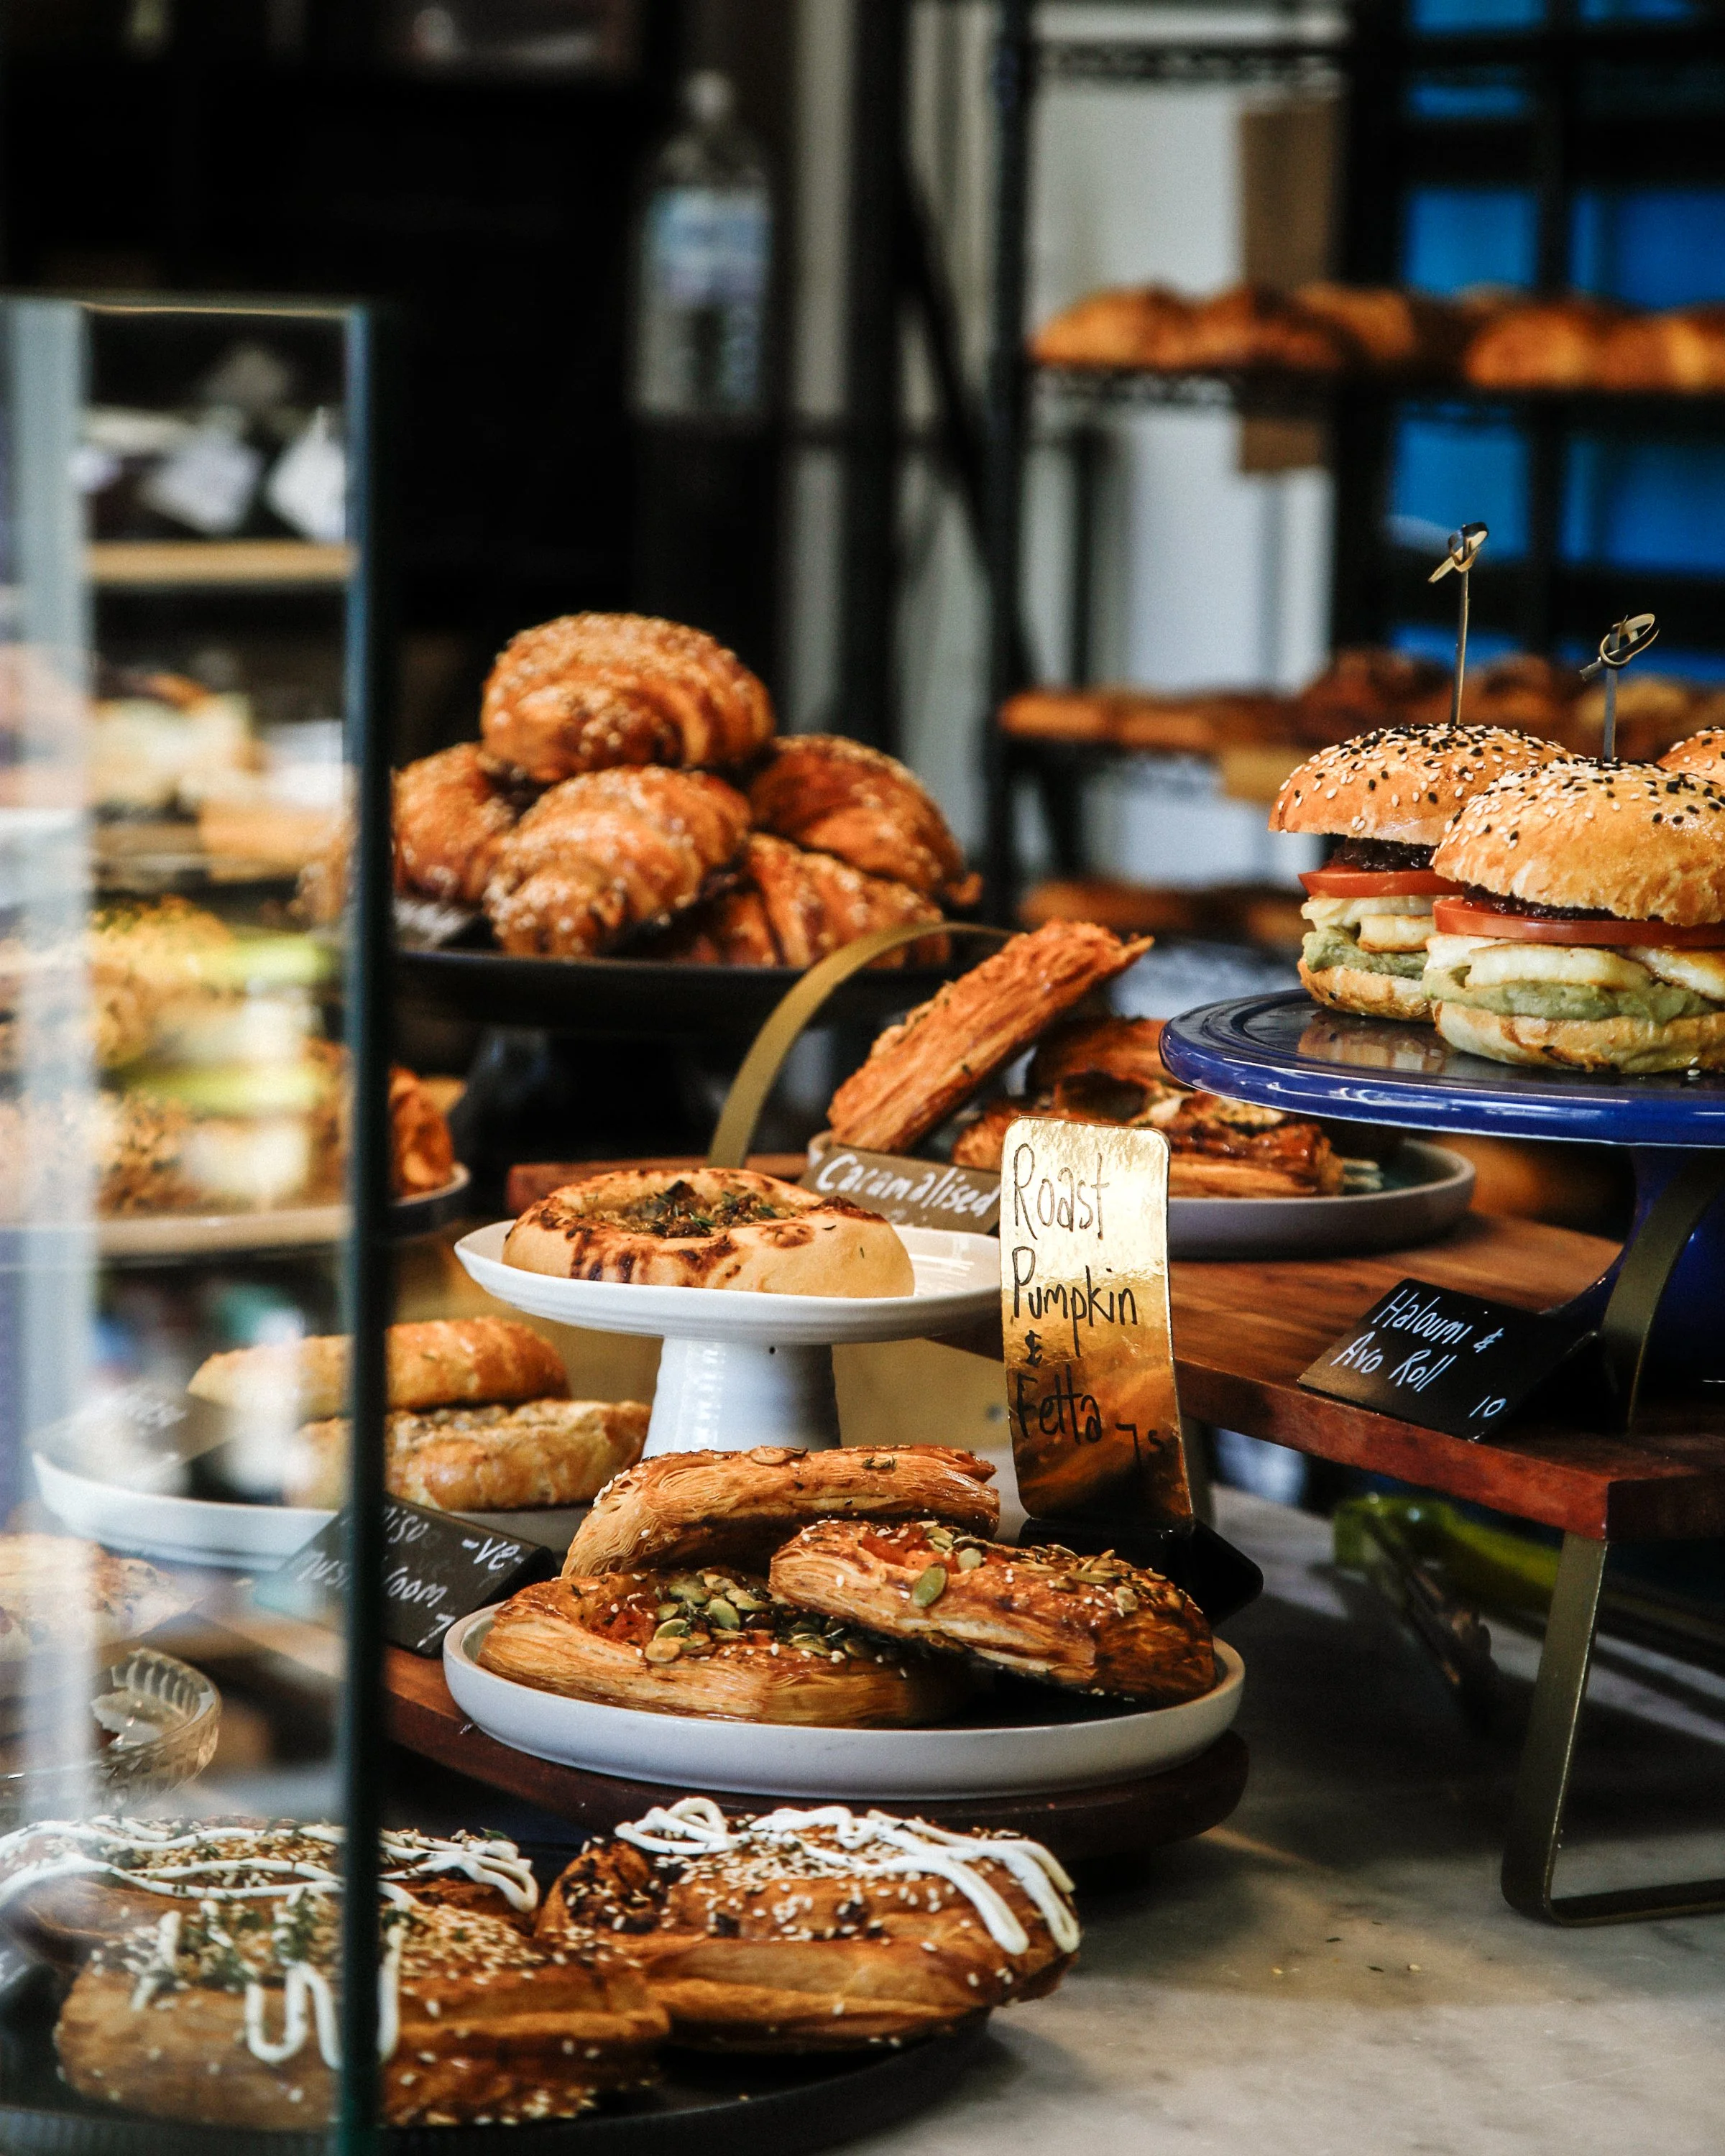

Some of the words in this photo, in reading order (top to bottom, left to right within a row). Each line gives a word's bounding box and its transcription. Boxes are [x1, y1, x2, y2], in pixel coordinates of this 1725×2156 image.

[1013, 1143, 1110, 1240] Roast
[1011, 1245, 1138, 1358] Pumpkin
[1371, 1289, 1473, 1345] Haloumi
[1473, 1327, 1504, 1353] &
[1330, 1331, 1384, 1373] Avo
[1388, 1348, 1458, 1392] Roll
[1016, 1364, 1103, 1445] Fetta
[1468, 1395, 1506, 1418] 10
[417, 1613, 456, 1648] 7
